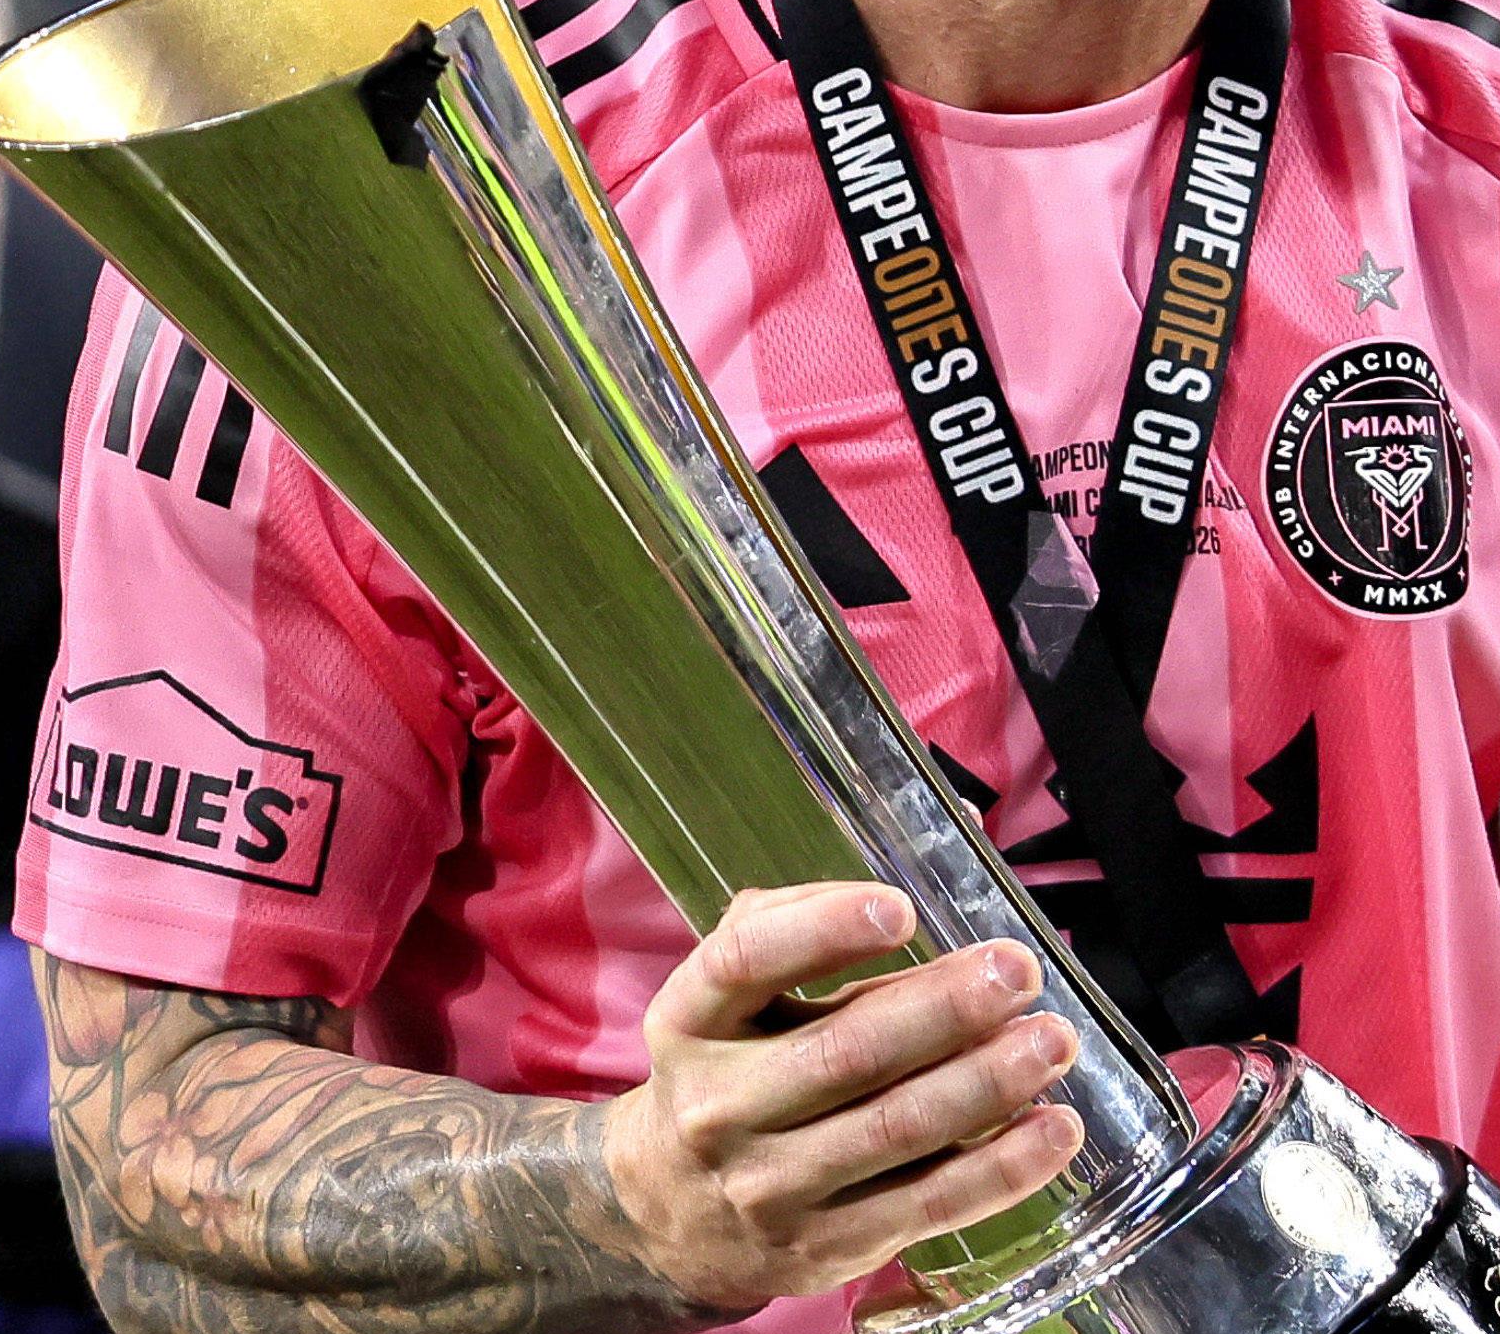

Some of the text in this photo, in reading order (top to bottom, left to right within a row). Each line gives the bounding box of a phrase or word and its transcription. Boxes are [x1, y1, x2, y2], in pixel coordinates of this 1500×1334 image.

[812, 67, 1025, 505] CAMPEONES CUP
[1118, 75, 1269, 525] CAMPEONES CUP
[1341, 415, 1436, 439] MIAMI
[1274, 487, 1314, 558] CLUB
[1364, 580, 1447, 606] MMXX
[47, 720, 295, 863] LOWE'S
